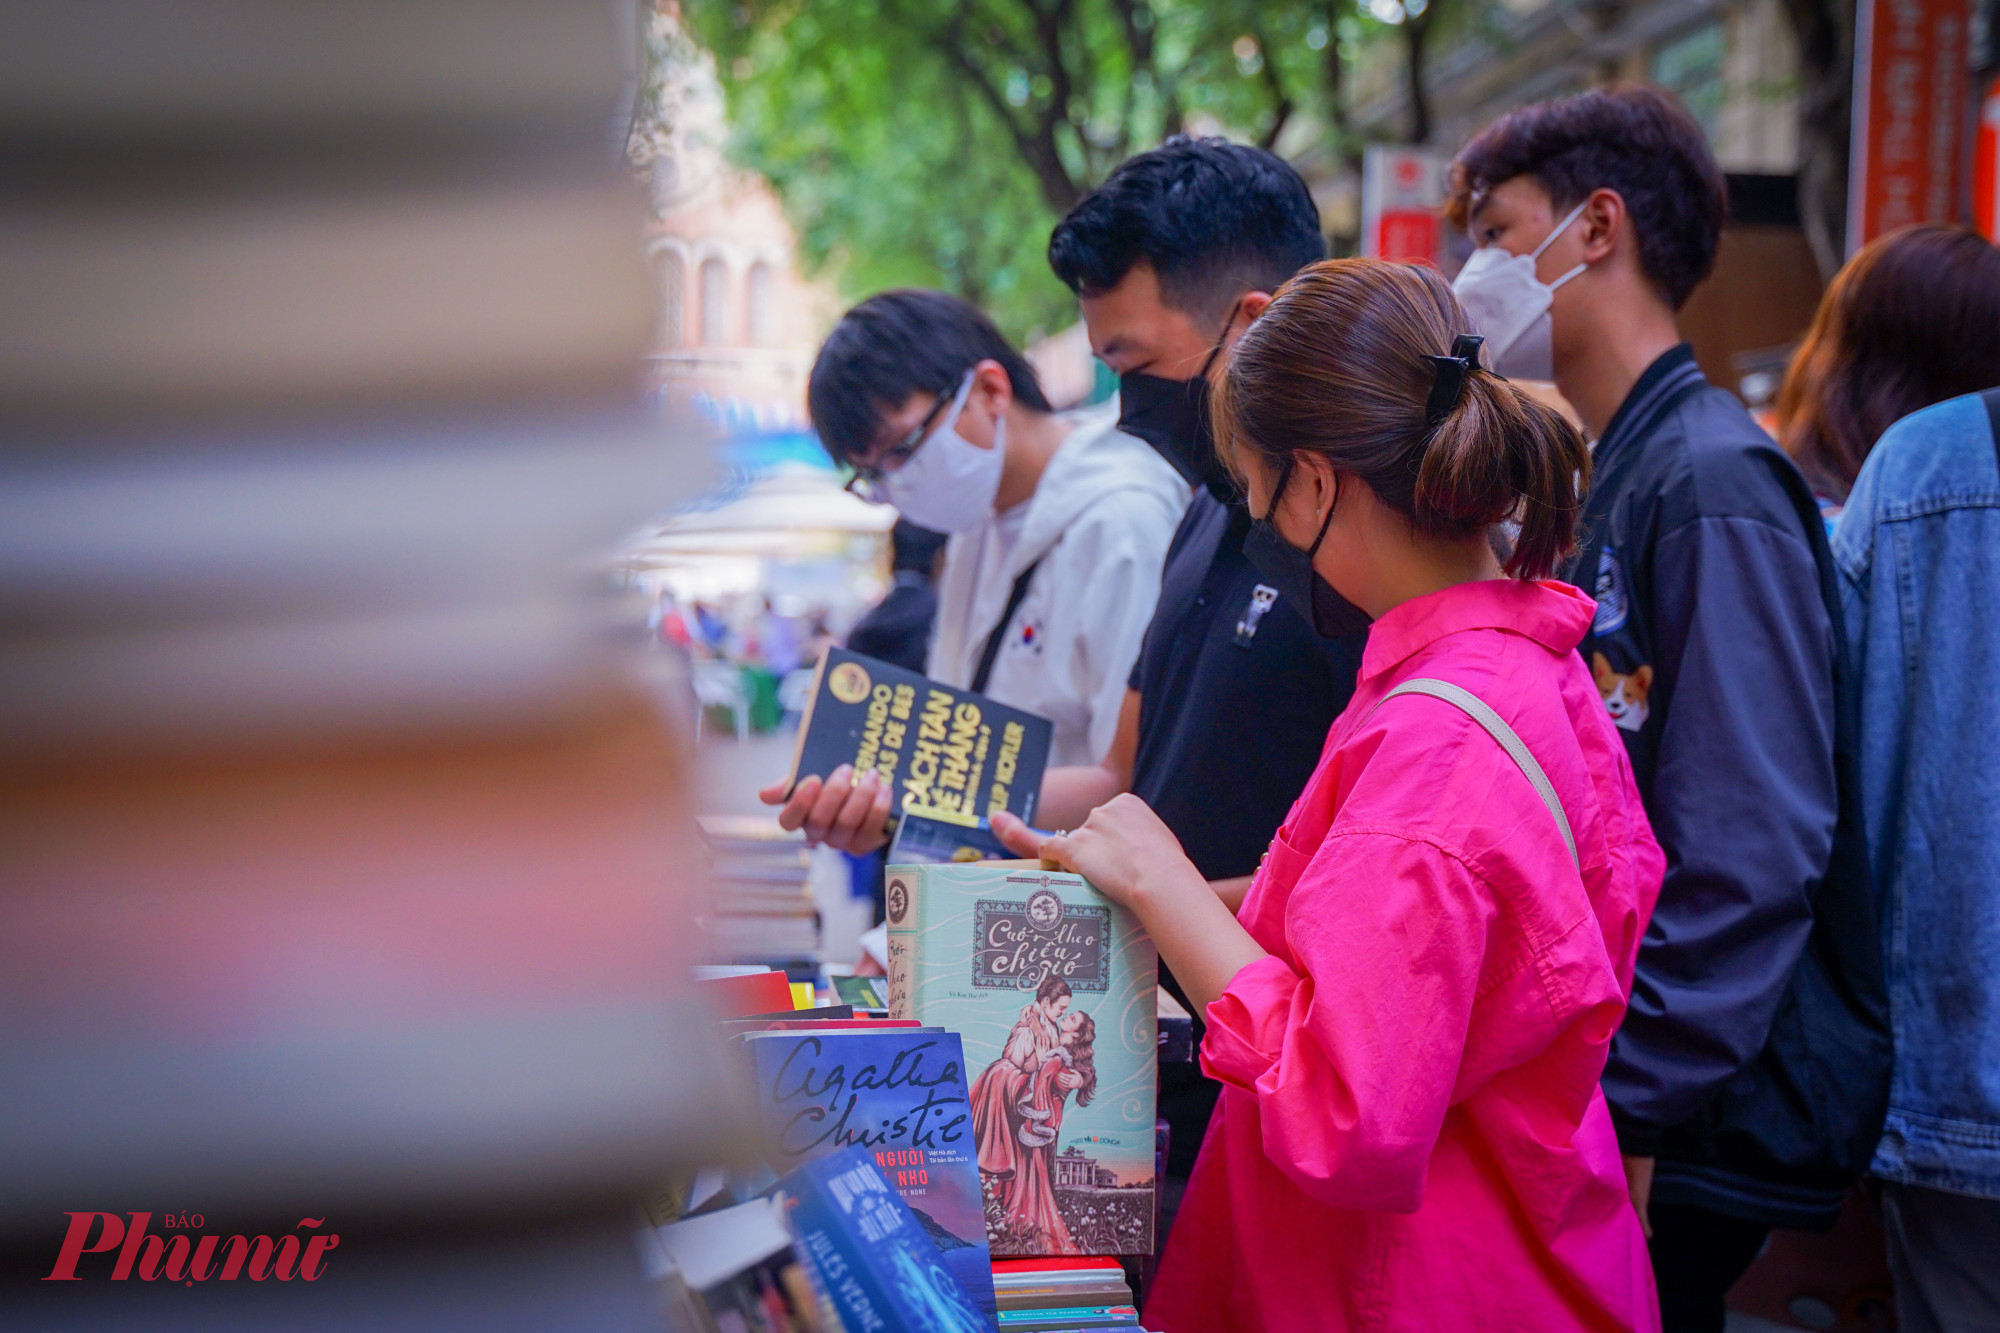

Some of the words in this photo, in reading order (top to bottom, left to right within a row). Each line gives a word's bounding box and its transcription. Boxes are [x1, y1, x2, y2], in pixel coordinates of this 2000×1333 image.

[882, 720, 907, 749] DE
[773, 1036, 961, 1112] Agatha
[779, 1088, 967, 1156] Christie
[876, 1147, 924, 1167] NGƯỜI
[807, 1229, 849, 1279] JULES
